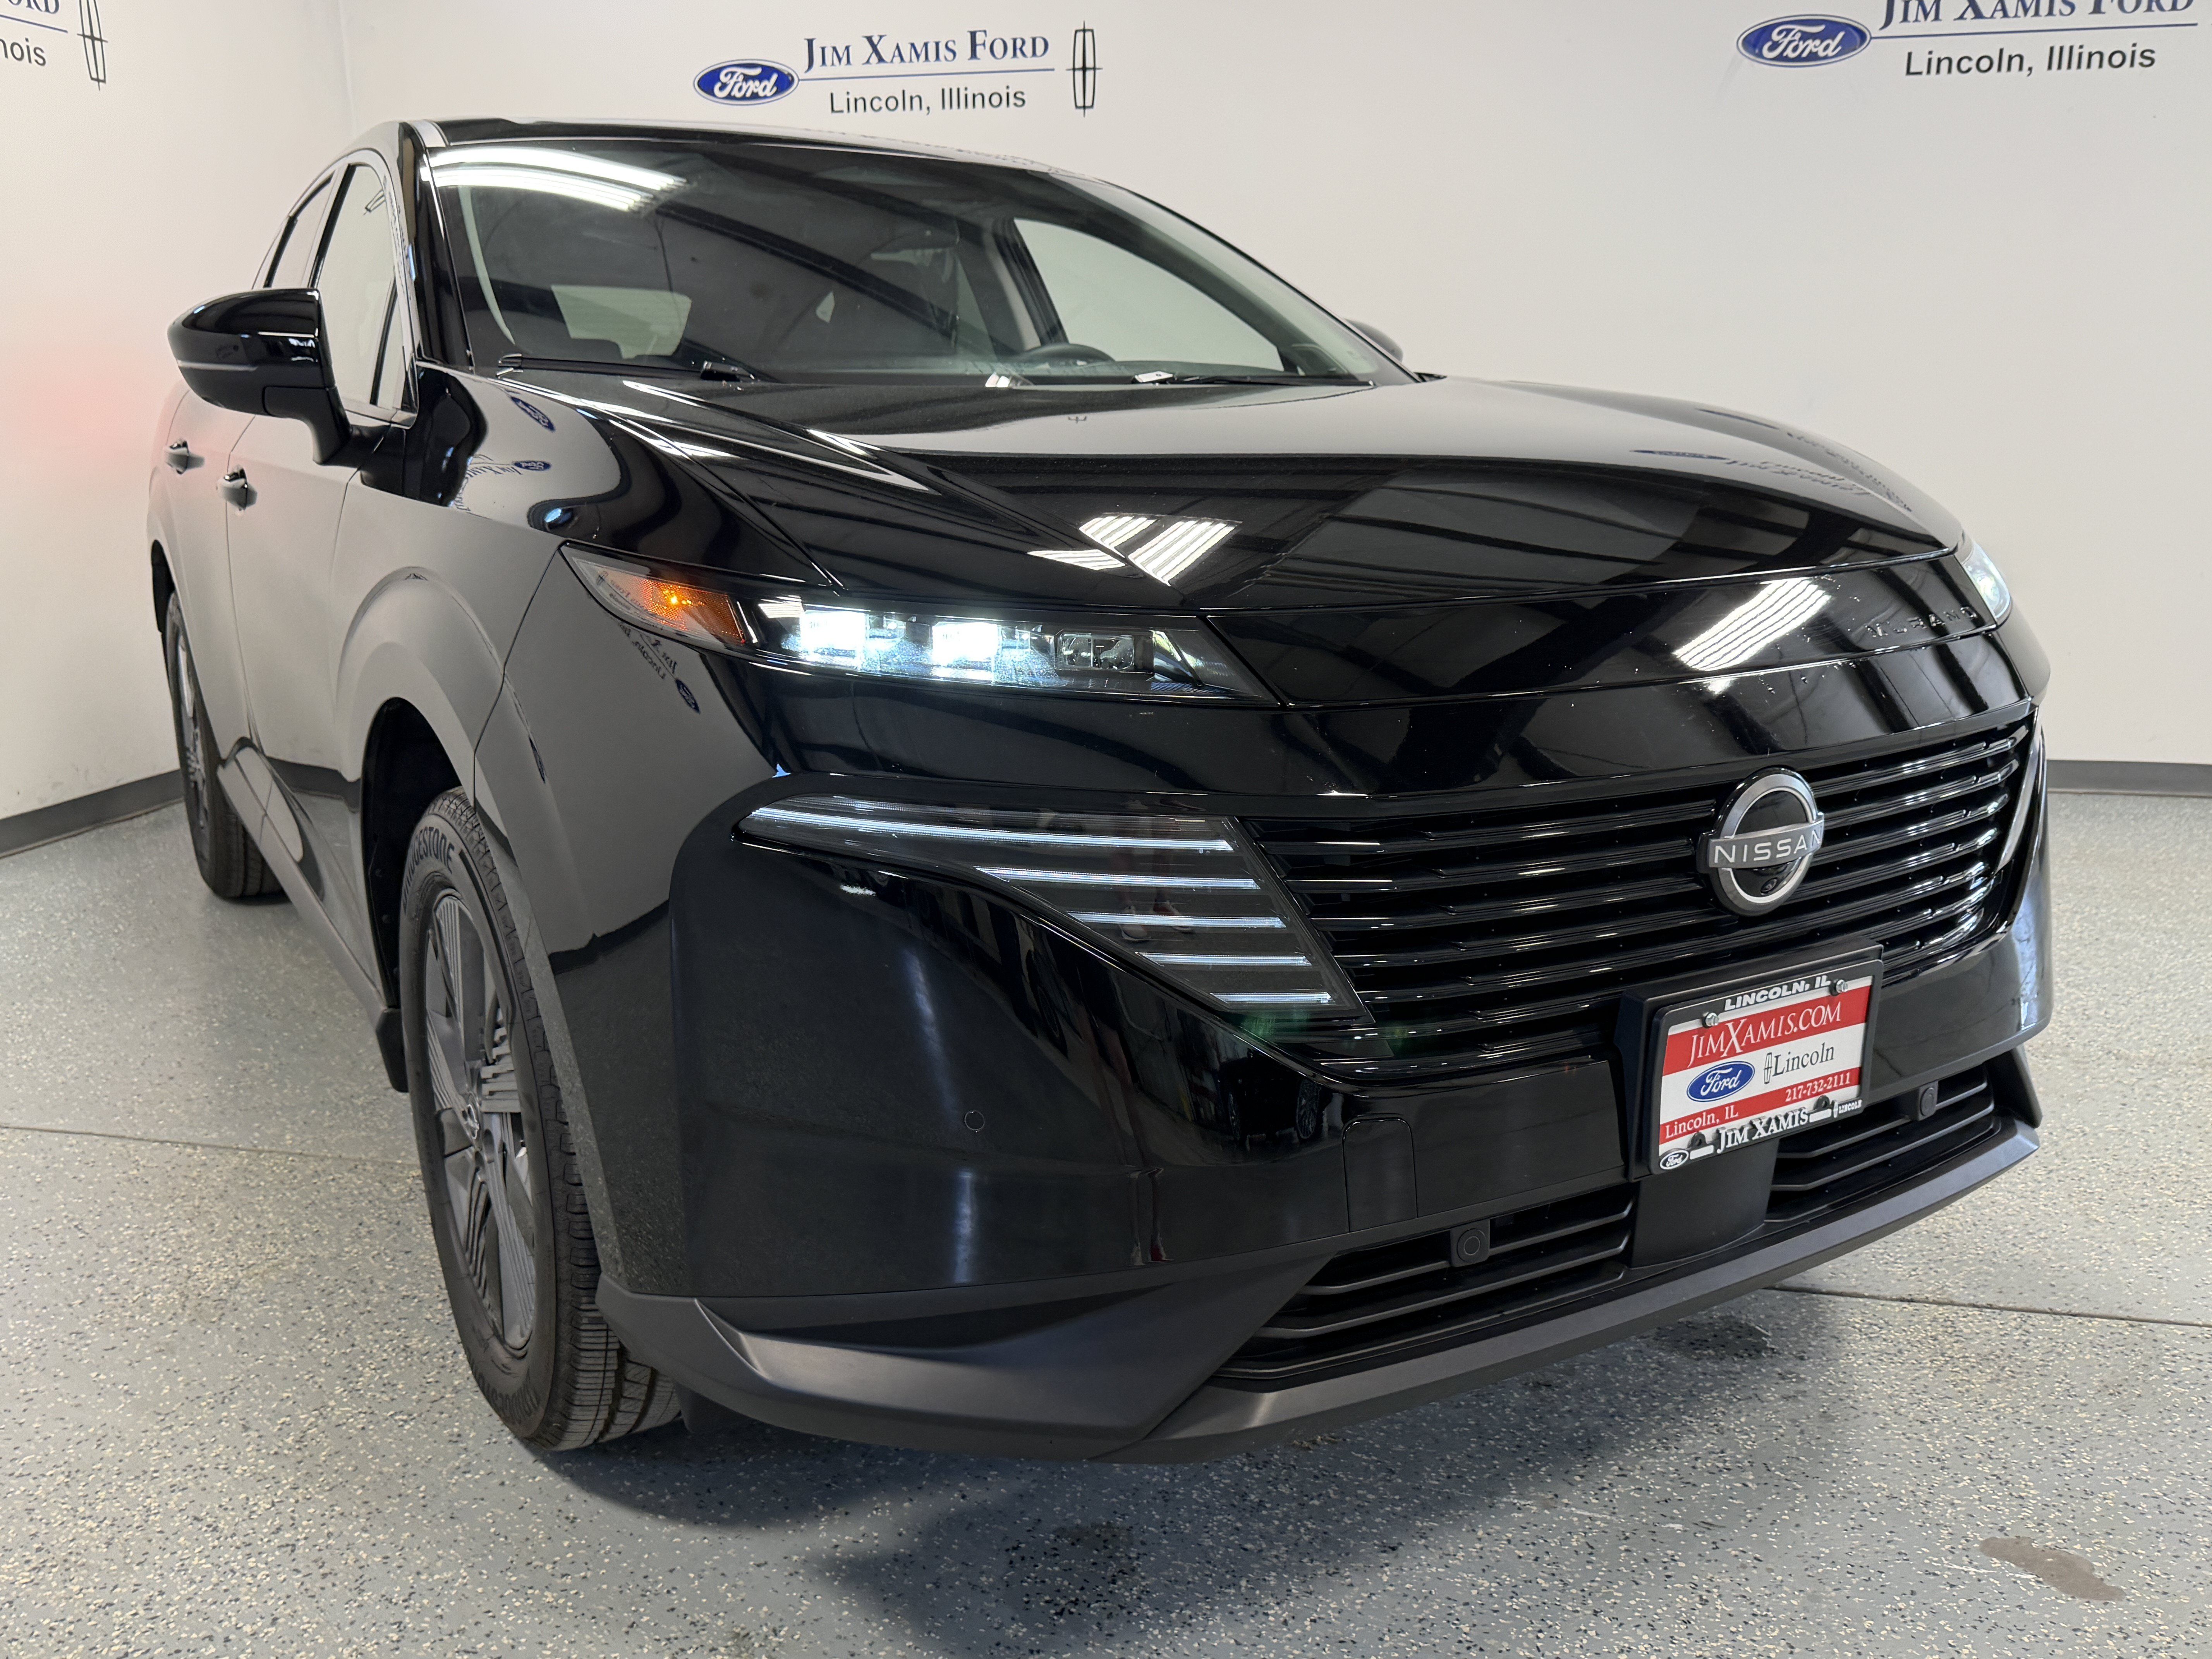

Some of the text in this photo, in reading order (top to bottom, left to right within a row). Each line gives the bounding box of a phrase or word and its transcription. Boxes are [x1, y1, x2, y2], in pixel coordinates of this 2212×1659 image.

[1879, 0, 1942, 31] JIM
[1953, 0, 2076, 21] XAMIS
[804, 29, 1049, 74] JIM XAMIS FORD
[1762, 24, 1846, 59] Ford
[1905, 43, 2156, 77] Lincoln, Illinois
[713, 67, 778, 98] Ford
[830, 85, 1026, 115] Lincoln, Illinois
[1714, 825, 1822, 863] NISSAN
[1724, 975, 1831, 1011] LINCOLN, IL
[1687, 1001, 1841, 1068] JIMXAMIS.COM
[1772, 1042, 1834, 1077] Lincoln
[1700, 1067, 1742, 1096] Ford
[1785, 1072, 1850, 1103] 217-732-2111
[1665, 1104, 1739, 1139] Lincoln, IL
[1838, 1099, 1863, 1114] LINCOLN
[1716, 1109, 1809, 1154] JIM XAMIS
